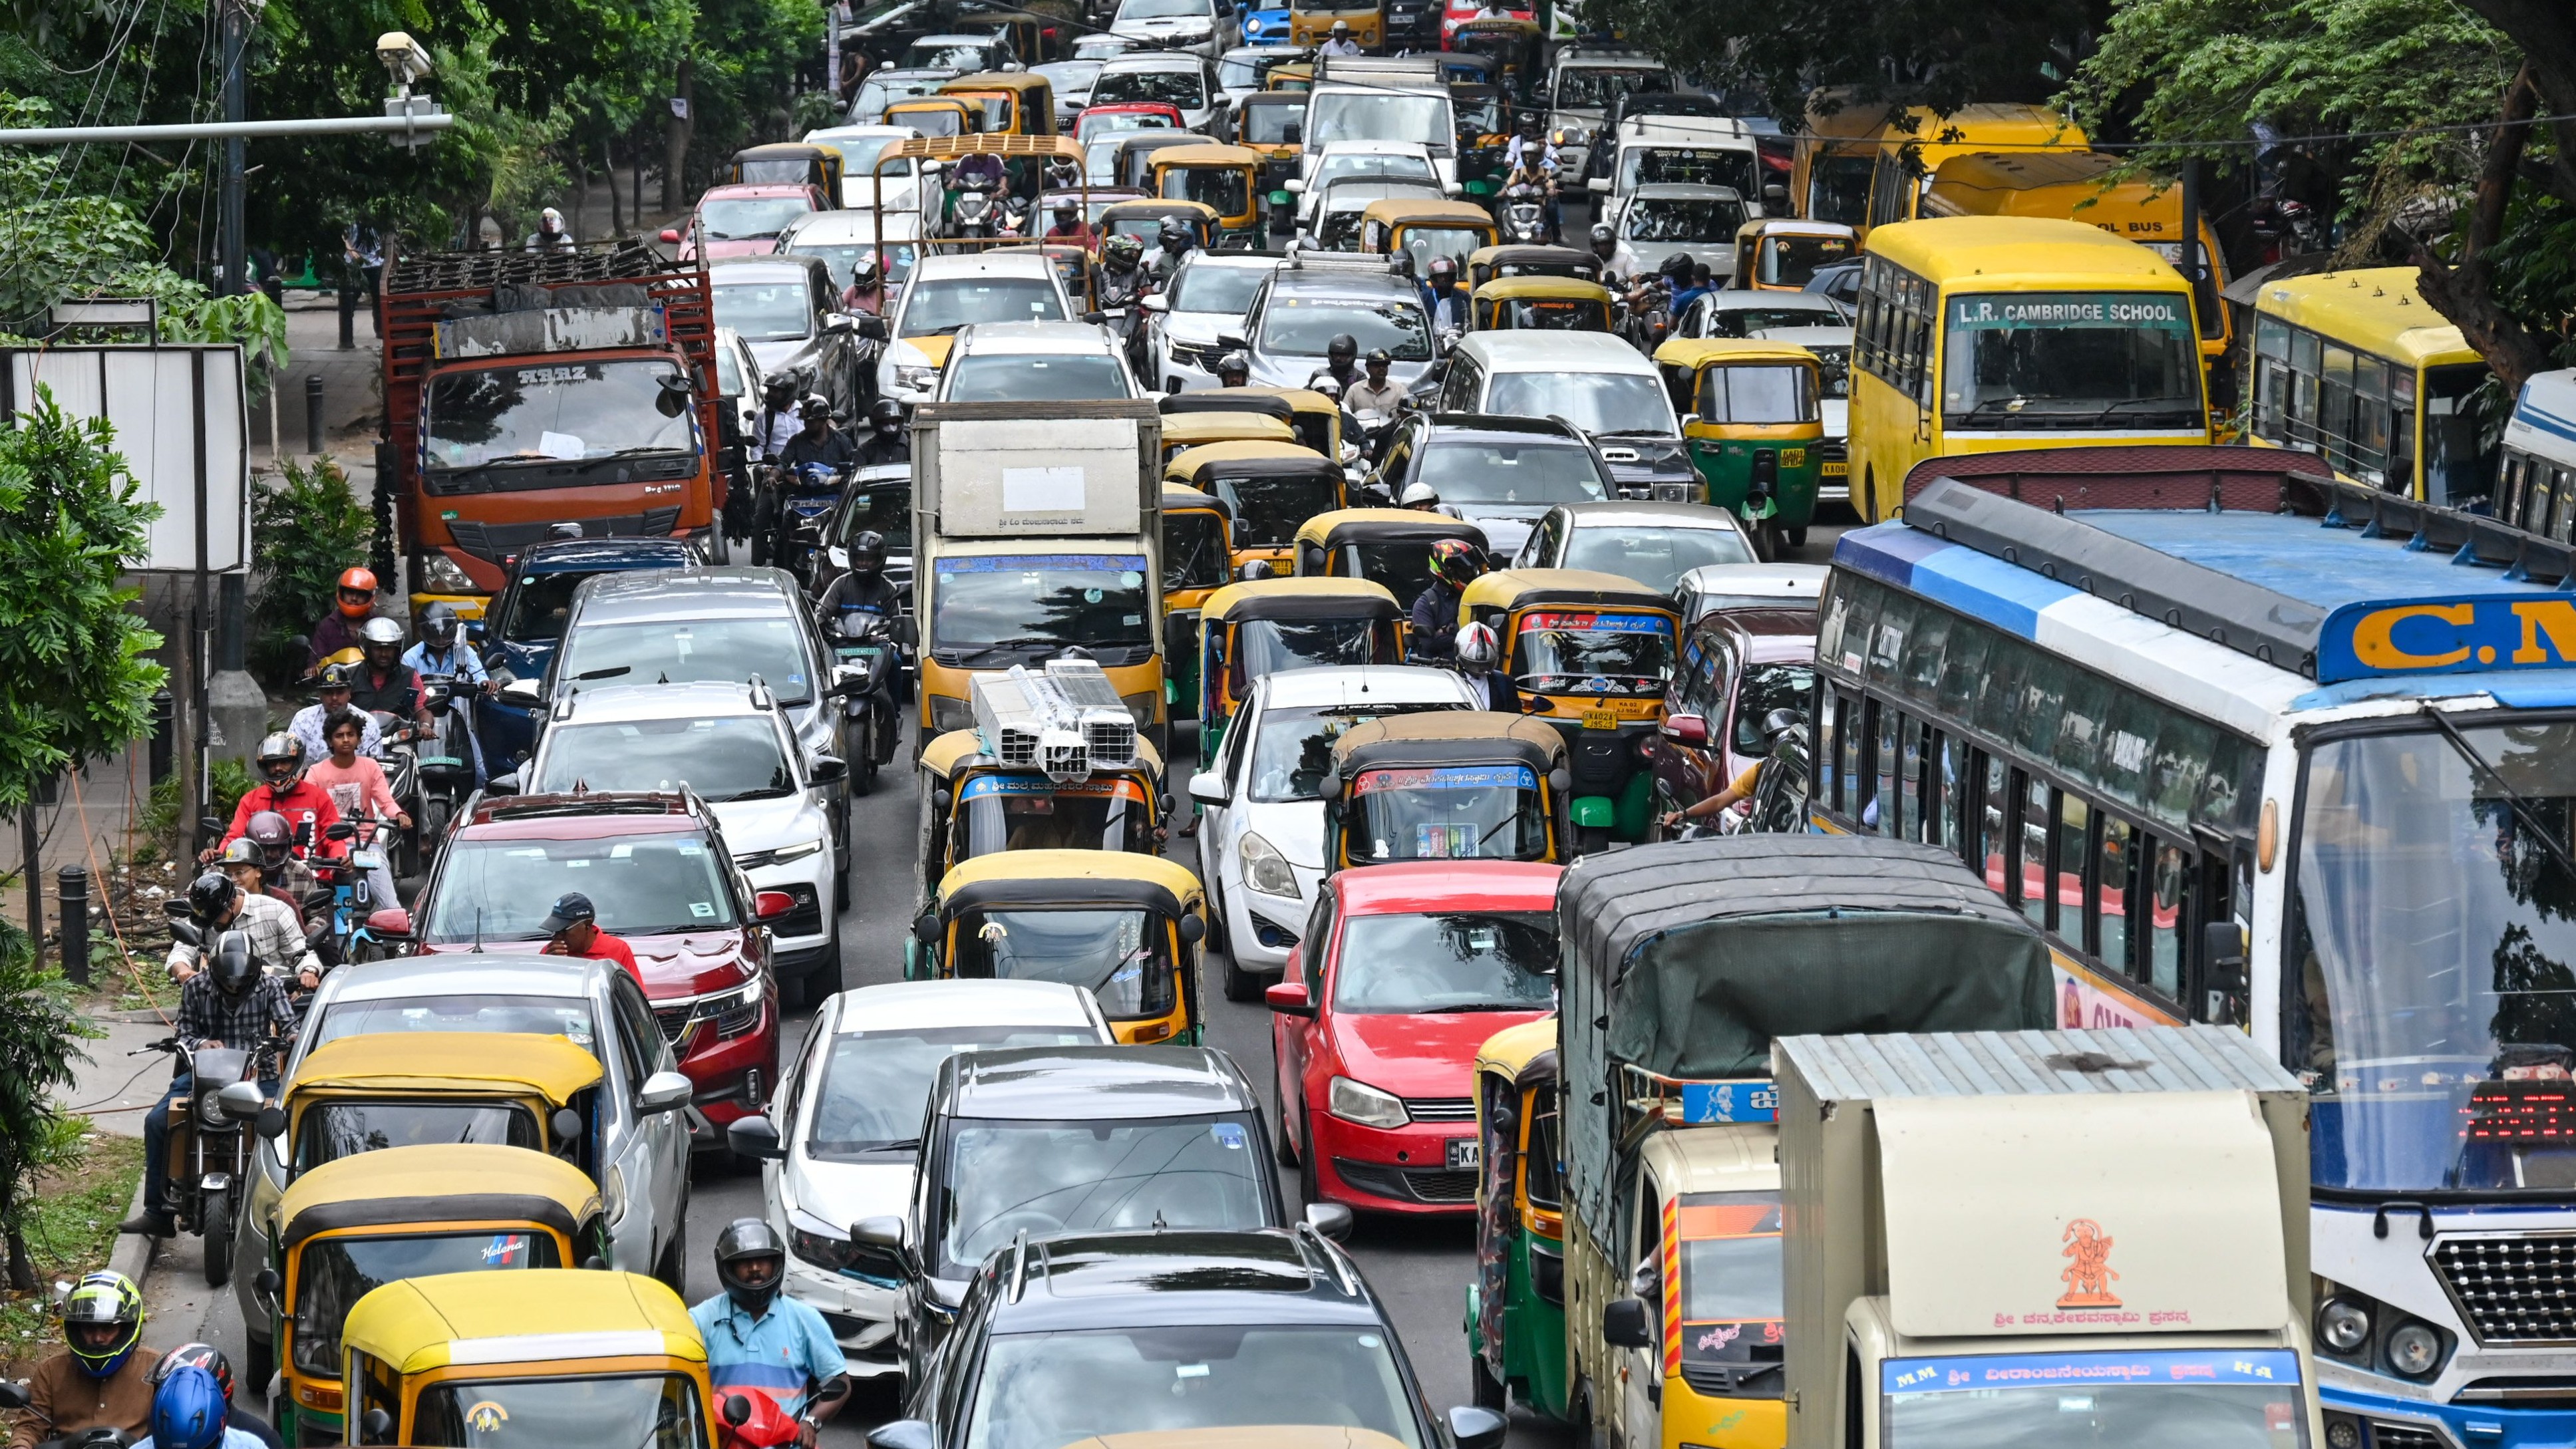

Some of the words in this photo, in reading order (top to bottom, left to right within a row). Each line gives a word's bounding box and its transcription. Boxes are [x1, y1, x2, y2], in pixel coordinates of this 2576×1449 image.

[2129, 222, 2162, 232] BUS
[1960, 303, 1999, 323] L.R.
[2005, 304, 2103, 320] CAMBRIDGE
[2110, 304, 2176, 321] SCHOOL
[481, 1241, 524, 1259] Helena
[1995, 1313, 2014, 1327] ಶ್ರೀ
[1947, 1369, 1970, 1386] ಶ್ರೀ
